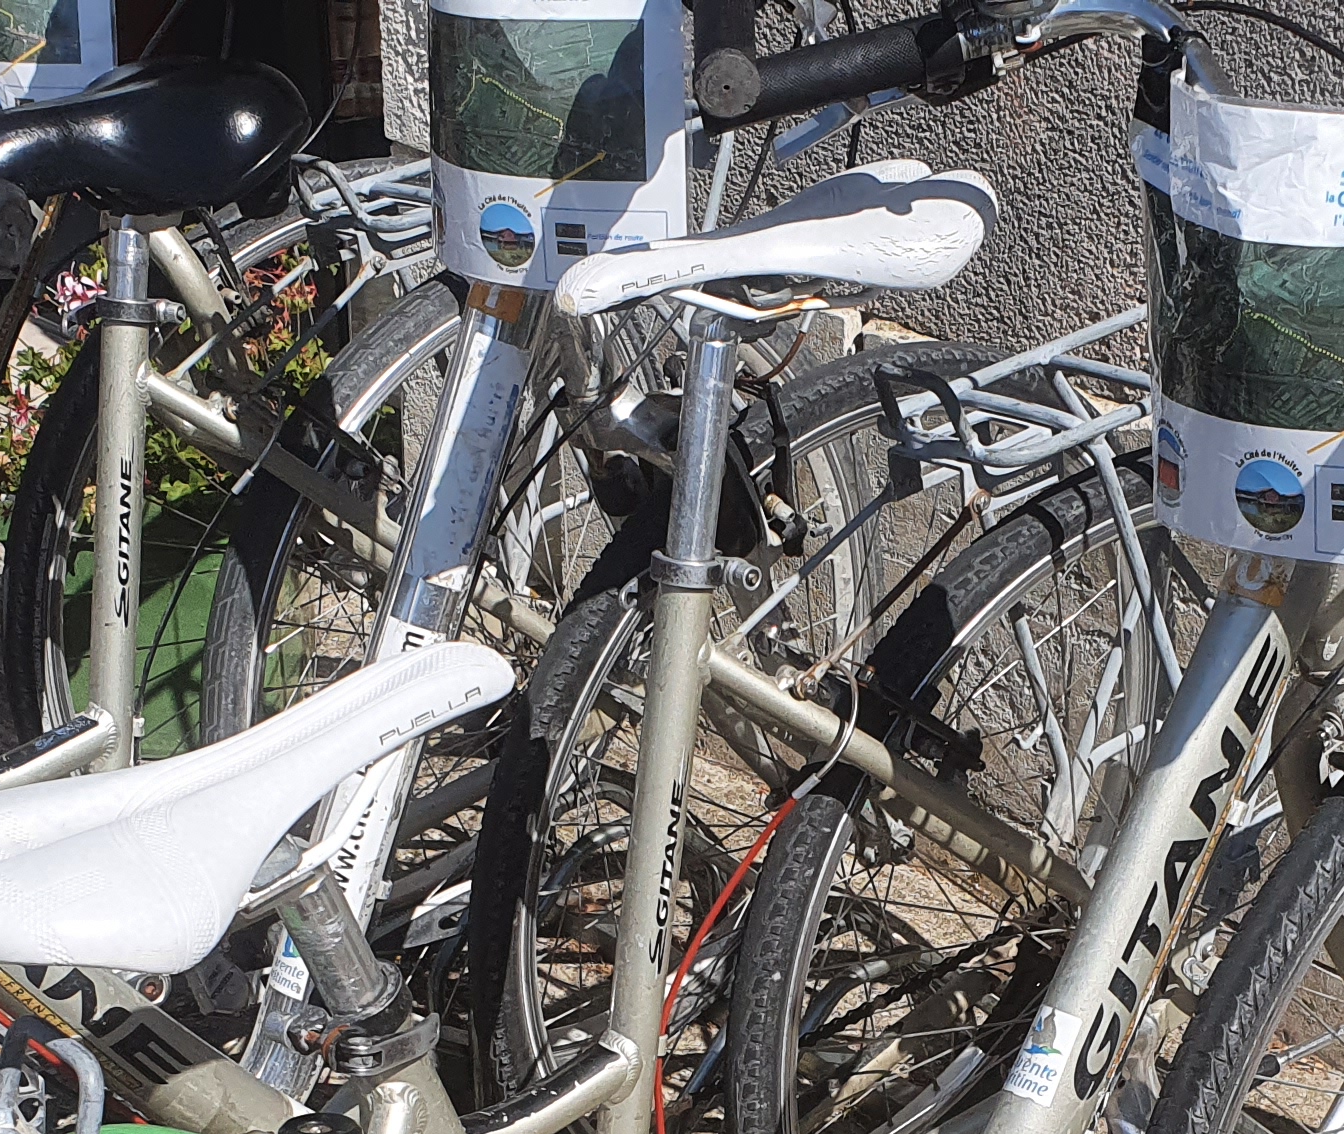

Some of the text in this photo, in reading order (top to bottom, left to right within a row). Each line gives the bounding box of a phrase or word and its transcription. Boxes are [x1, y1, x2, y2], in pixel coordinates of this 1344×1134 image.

[1325, 191, 1335, 203] la
[621, 263, 705, 294] PUELLA
[1244, 450, 1260, 460] Cité
[1260, 448, 1272, 459] de
[117, 456, 133, 586] GITANE
[379, 686, 482, 746] PUELLA
[655, 778, 684, 928] GITANE
[1073, 632, 1286, 1101] GITANE
[6, 979, 68, 1031] FRANCE
